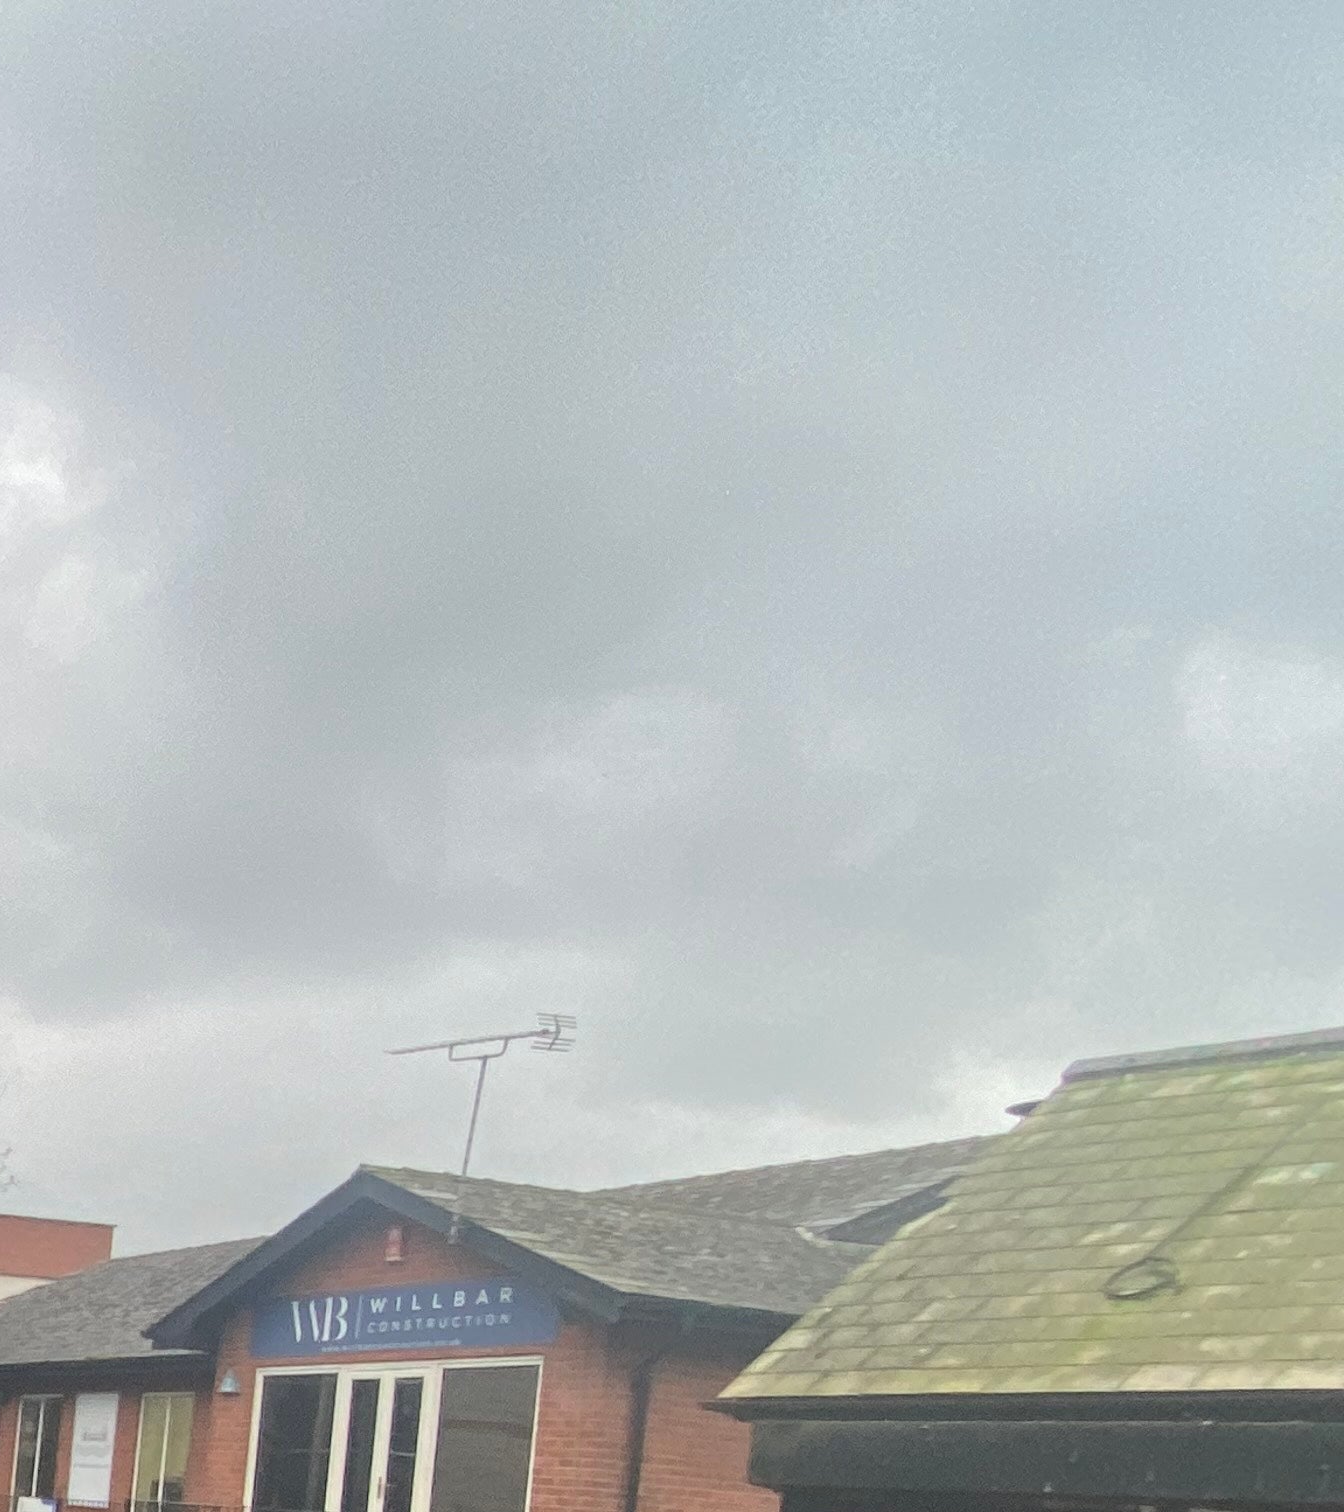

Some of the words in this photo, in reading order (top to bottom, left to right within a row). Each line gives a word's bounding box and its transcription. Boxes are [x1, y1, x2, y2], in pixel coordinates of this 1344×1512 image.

[370, 1287, 514, 1314] WILLBAR
[291, 1296, 349, 1343] WB
[366, 1314, 512, 1335] CONSTRUCTION
